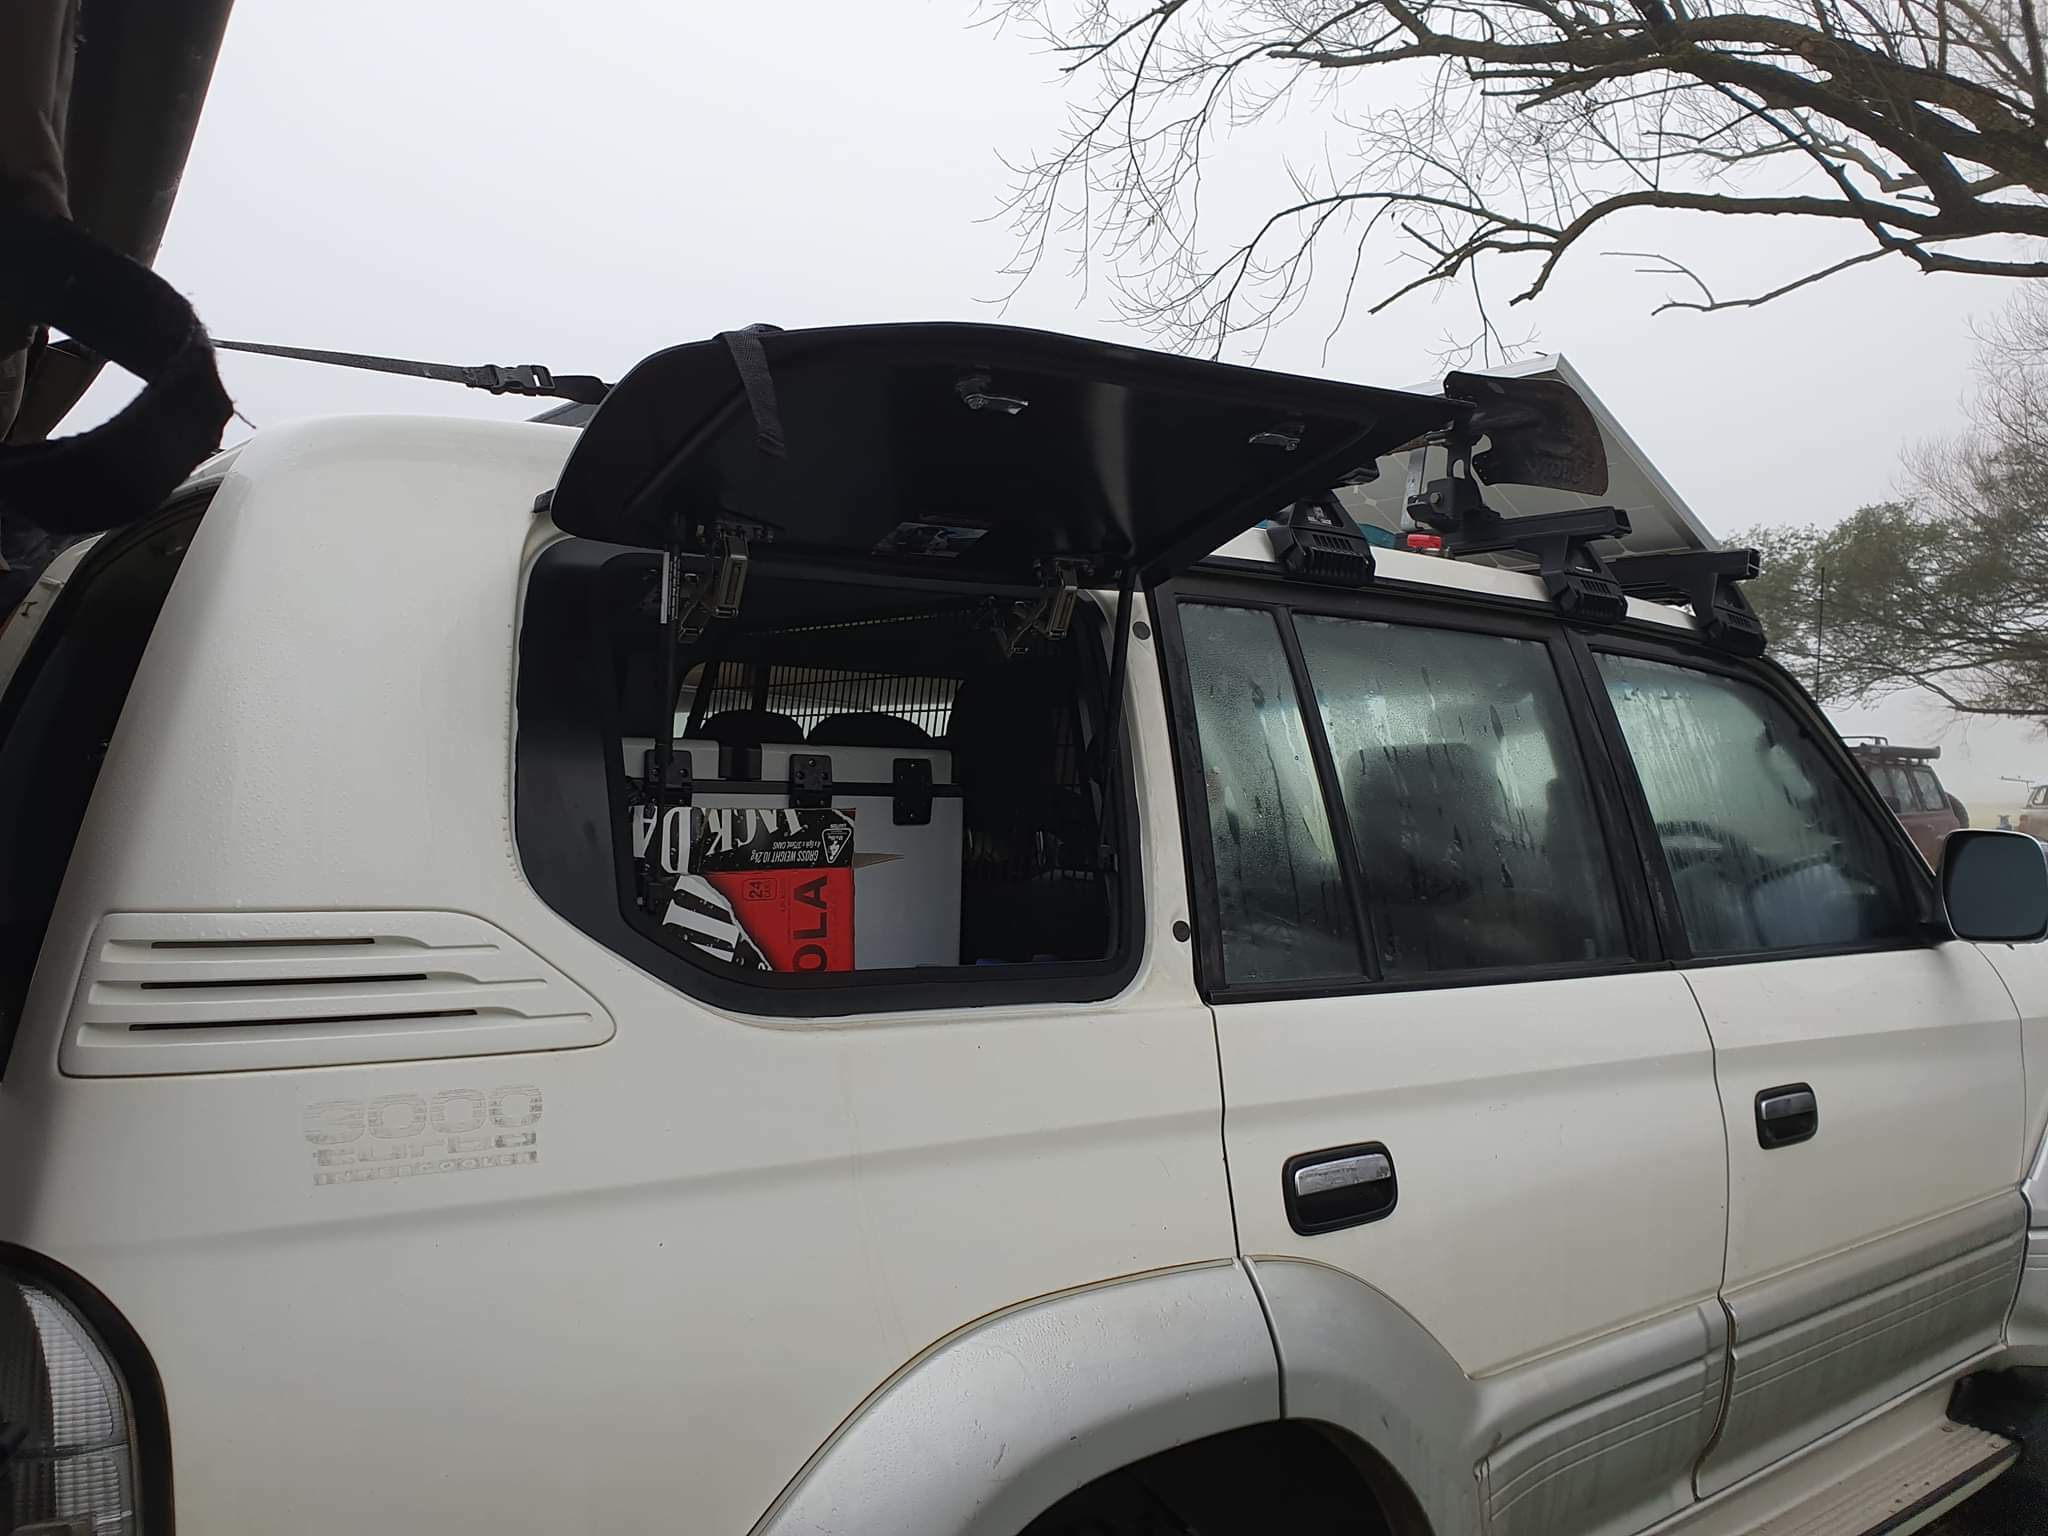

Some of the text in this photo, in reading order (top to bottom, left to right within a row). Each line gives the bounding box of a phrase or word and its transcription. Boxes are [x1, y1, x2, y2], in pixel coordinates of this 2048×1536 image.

[772, 841, 787, 849] CANS
[750, 849, 819, 863] GROSS WEIGHT 10.2kg
[748, 881, 763, 898] 24
[791, 876, 828, 971] OLA
[304, 1085, 543, 1145] 3000
